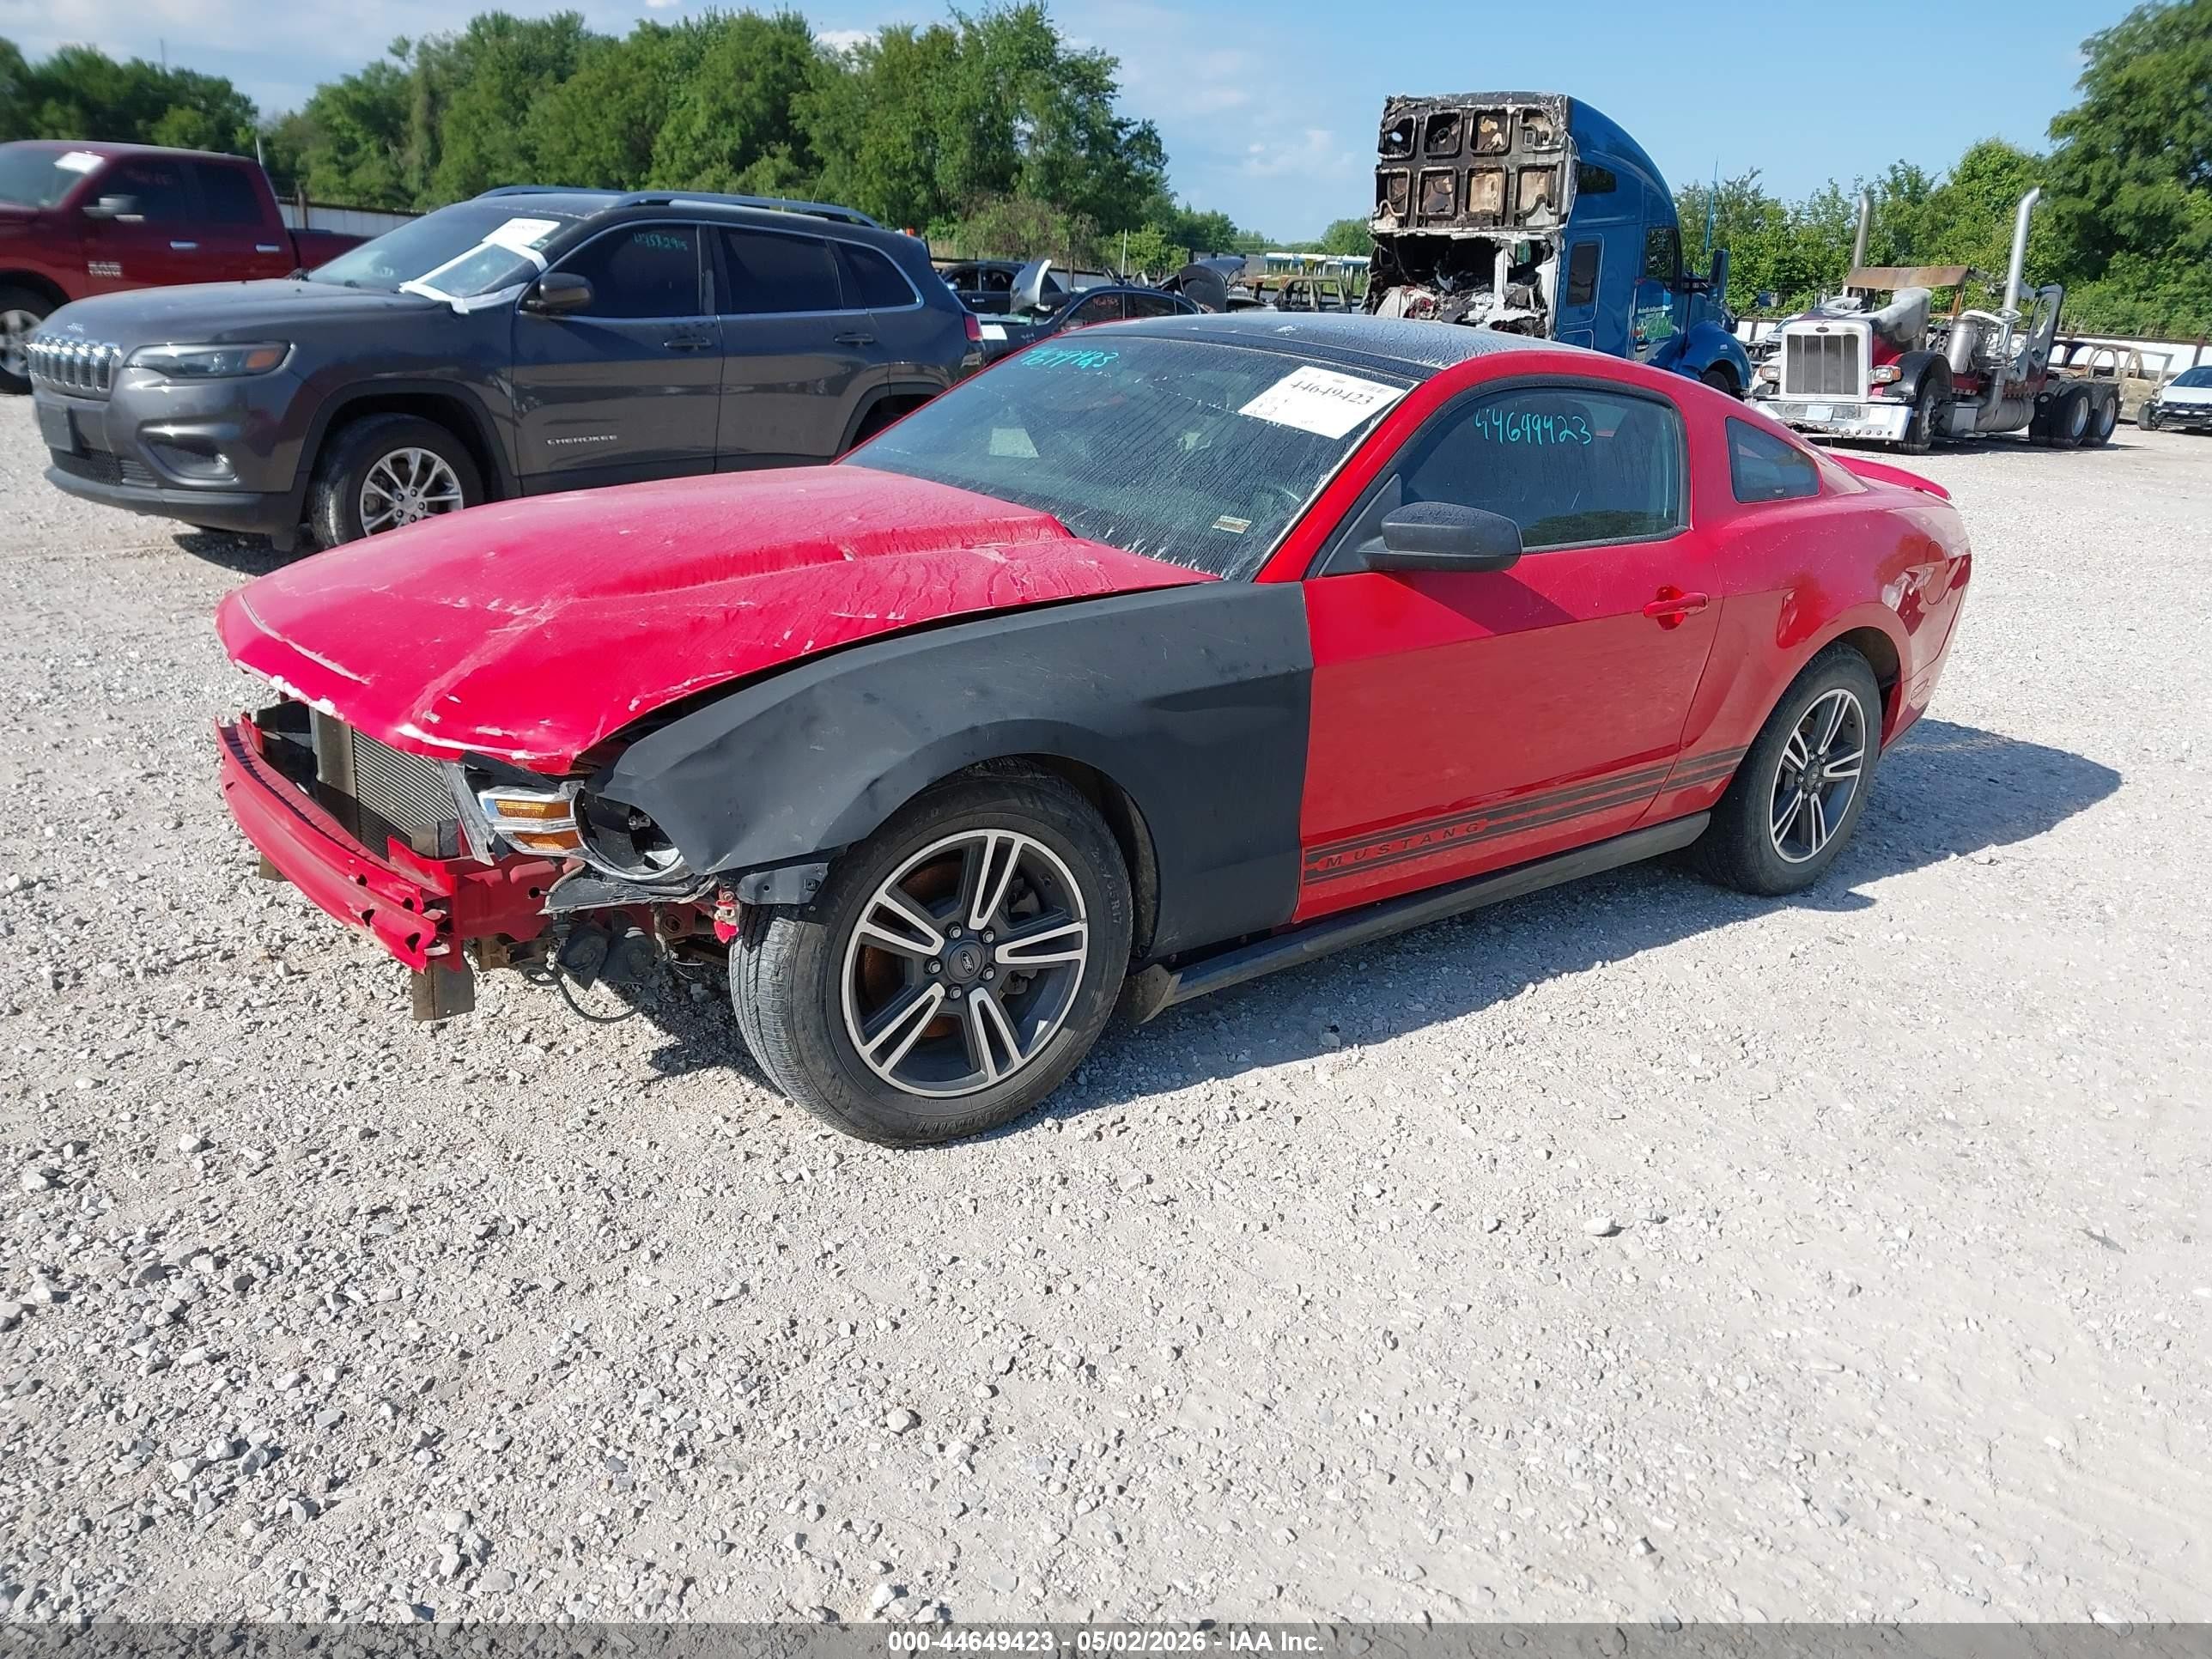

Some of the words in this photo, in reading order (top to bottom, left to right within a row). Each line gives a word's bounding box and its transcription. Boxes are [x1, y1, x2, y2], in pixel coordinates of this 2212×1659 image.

[1291, 380, 1375, 405] 44649423
[546, 434, 617, 445] CHEROKEE
[1475, 408, 1592, 445] 44649423
[1325, 823, 1479, 867] MUSTANG
